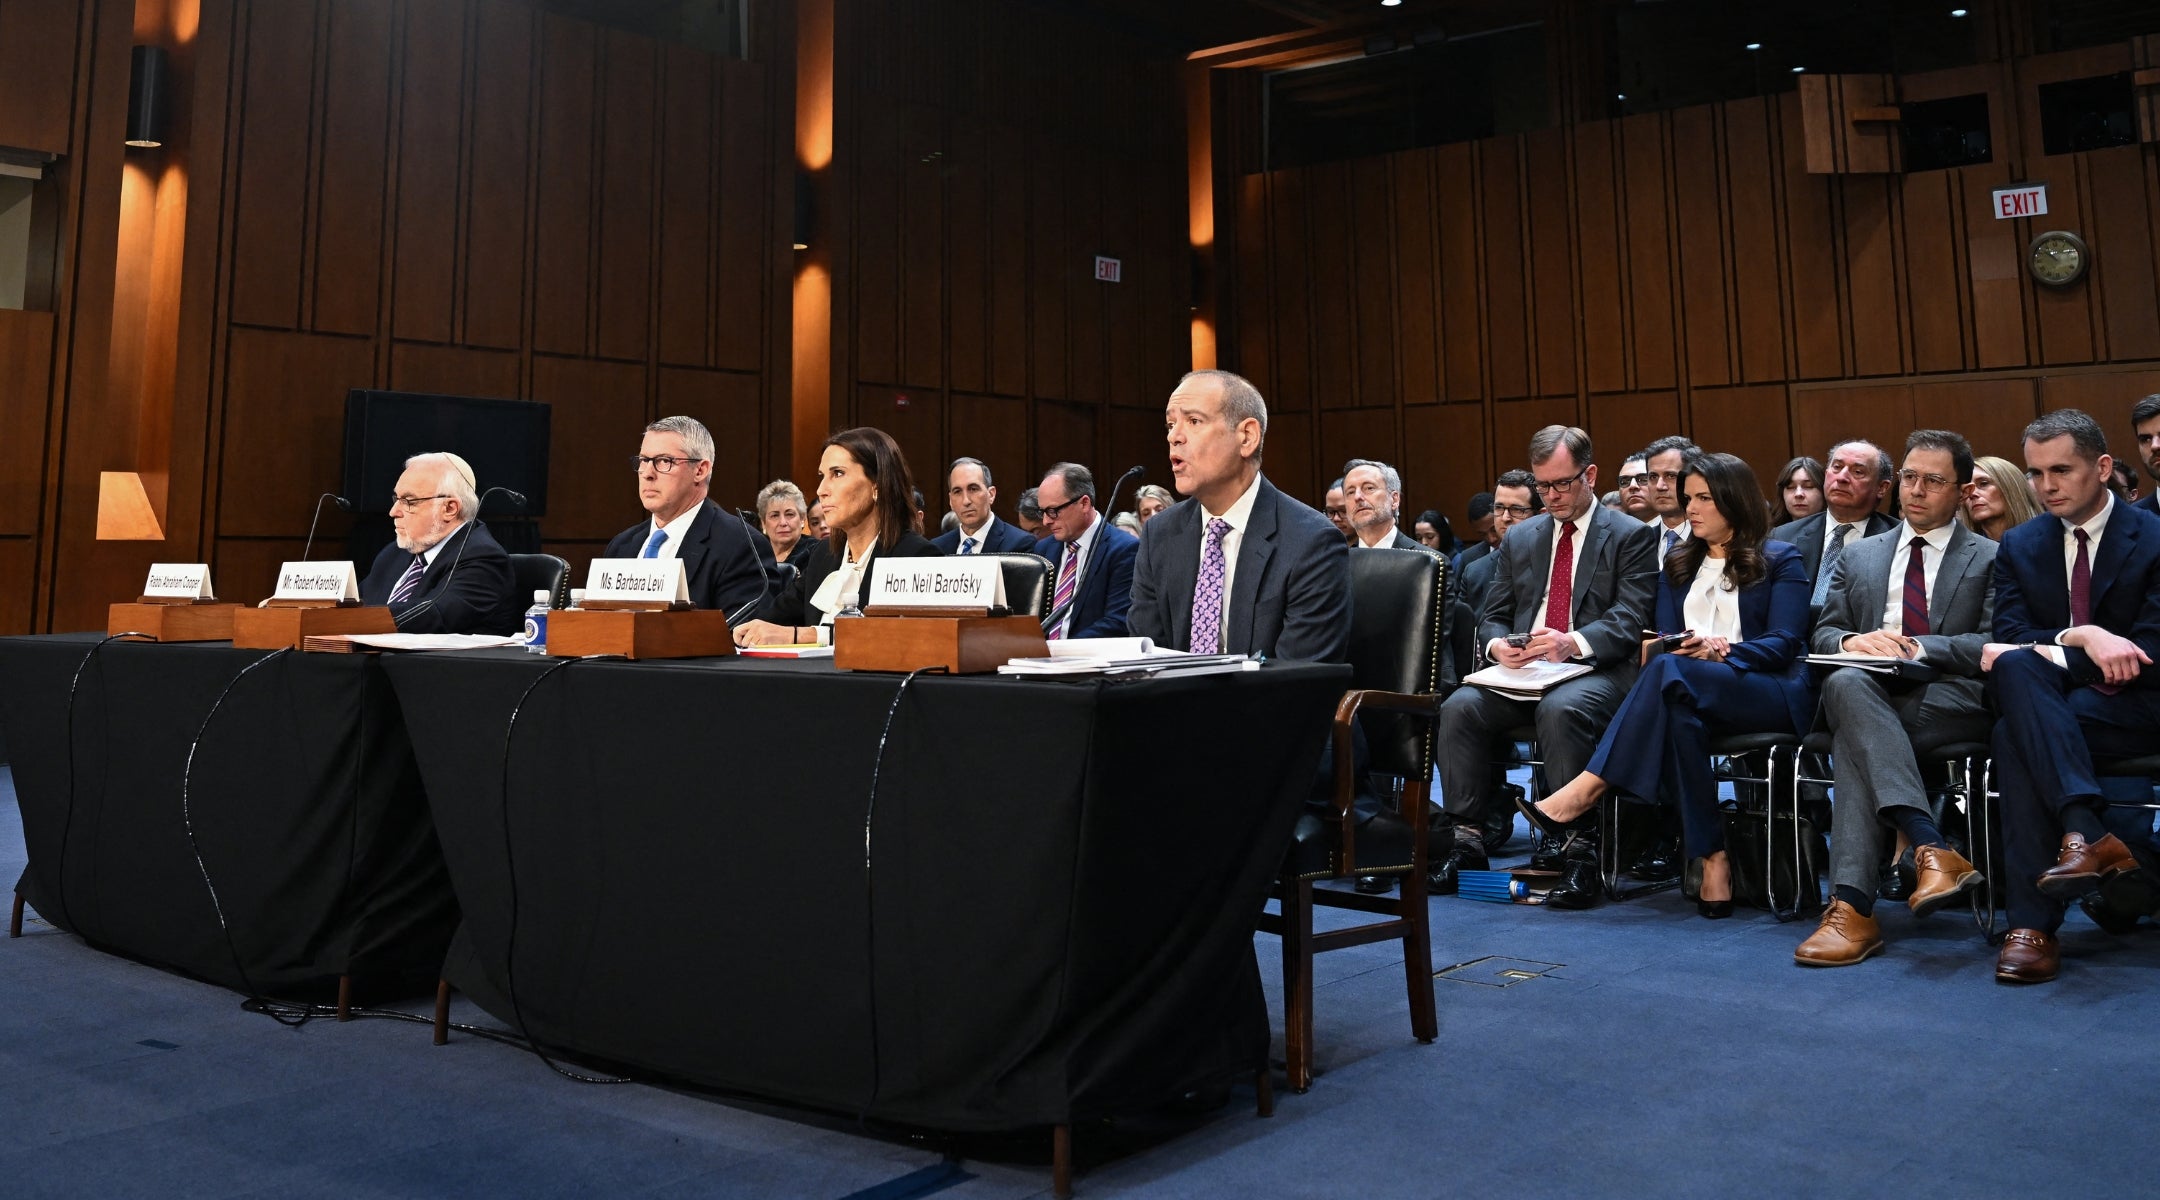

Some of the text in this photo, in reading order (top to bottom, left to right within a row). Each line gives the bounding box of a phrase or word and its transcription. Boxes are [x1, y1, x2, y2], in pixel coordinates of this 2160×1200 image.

[2001, 191, 2039, 217] EXIT
[1099, 260, 1118, 280] EXIT
[182, 575, 200, 590] Cooper
[282, 574, 342, 595] Mr. Robert Karofsky
[600, 572, 665, 592] Ms. Barbara Levi
[885, 573, 982, 599] Hon. Neil Barofsky
